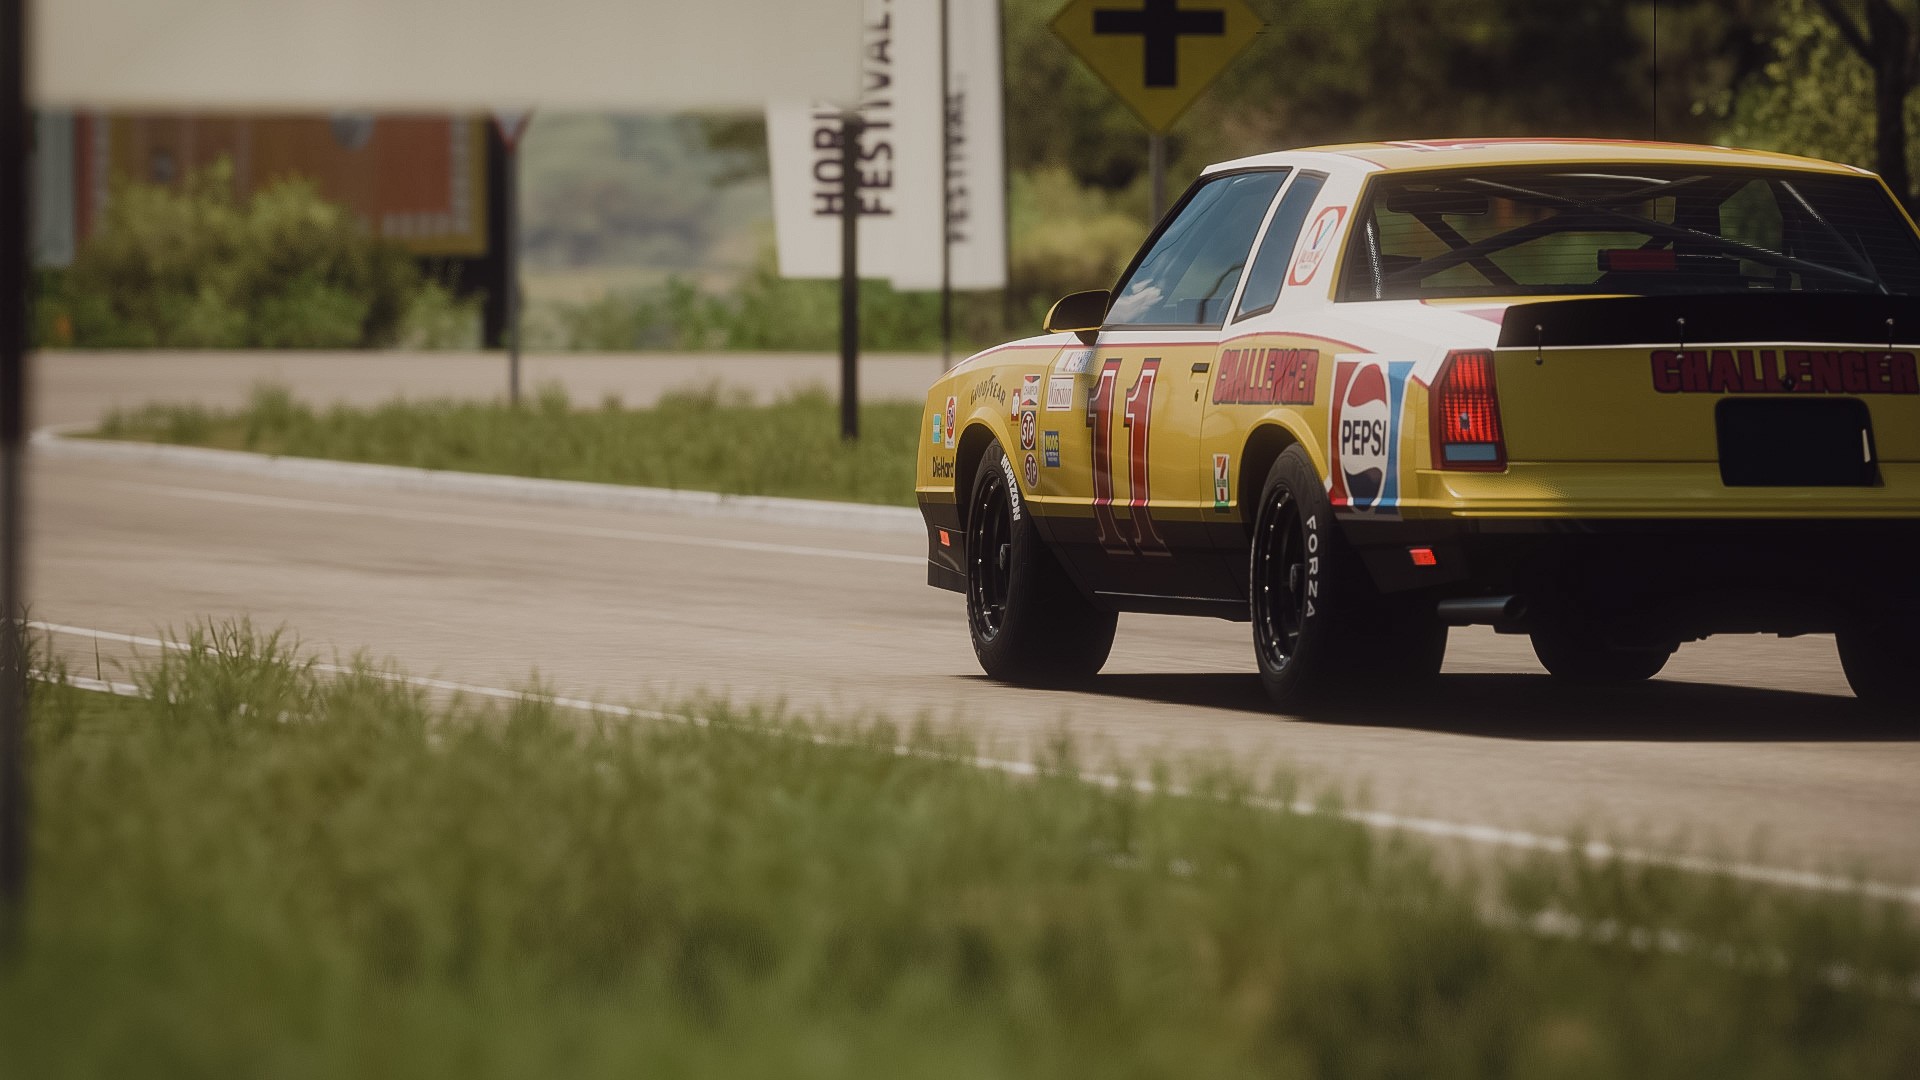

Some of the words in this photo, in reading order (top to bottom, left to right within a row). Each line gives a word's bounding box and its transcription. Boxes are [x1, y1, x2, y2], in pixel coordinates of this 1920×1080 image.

[814, 112, 844, 216] HORI
[1212, 348, 1319, 405] CHALLENGER
[1651, 350, 1920, 394] CHALLENGER
[1021, 415, 1034, 443] STP
[1086, 357, 1172, 557] 11
[1342, 419, 1387, 456] PEPSI
[1000, 453, 1021, 521] HORIZON
[1025, 455, 1038, 482] STP
[1306, 515, 1319, 617] FORZA
